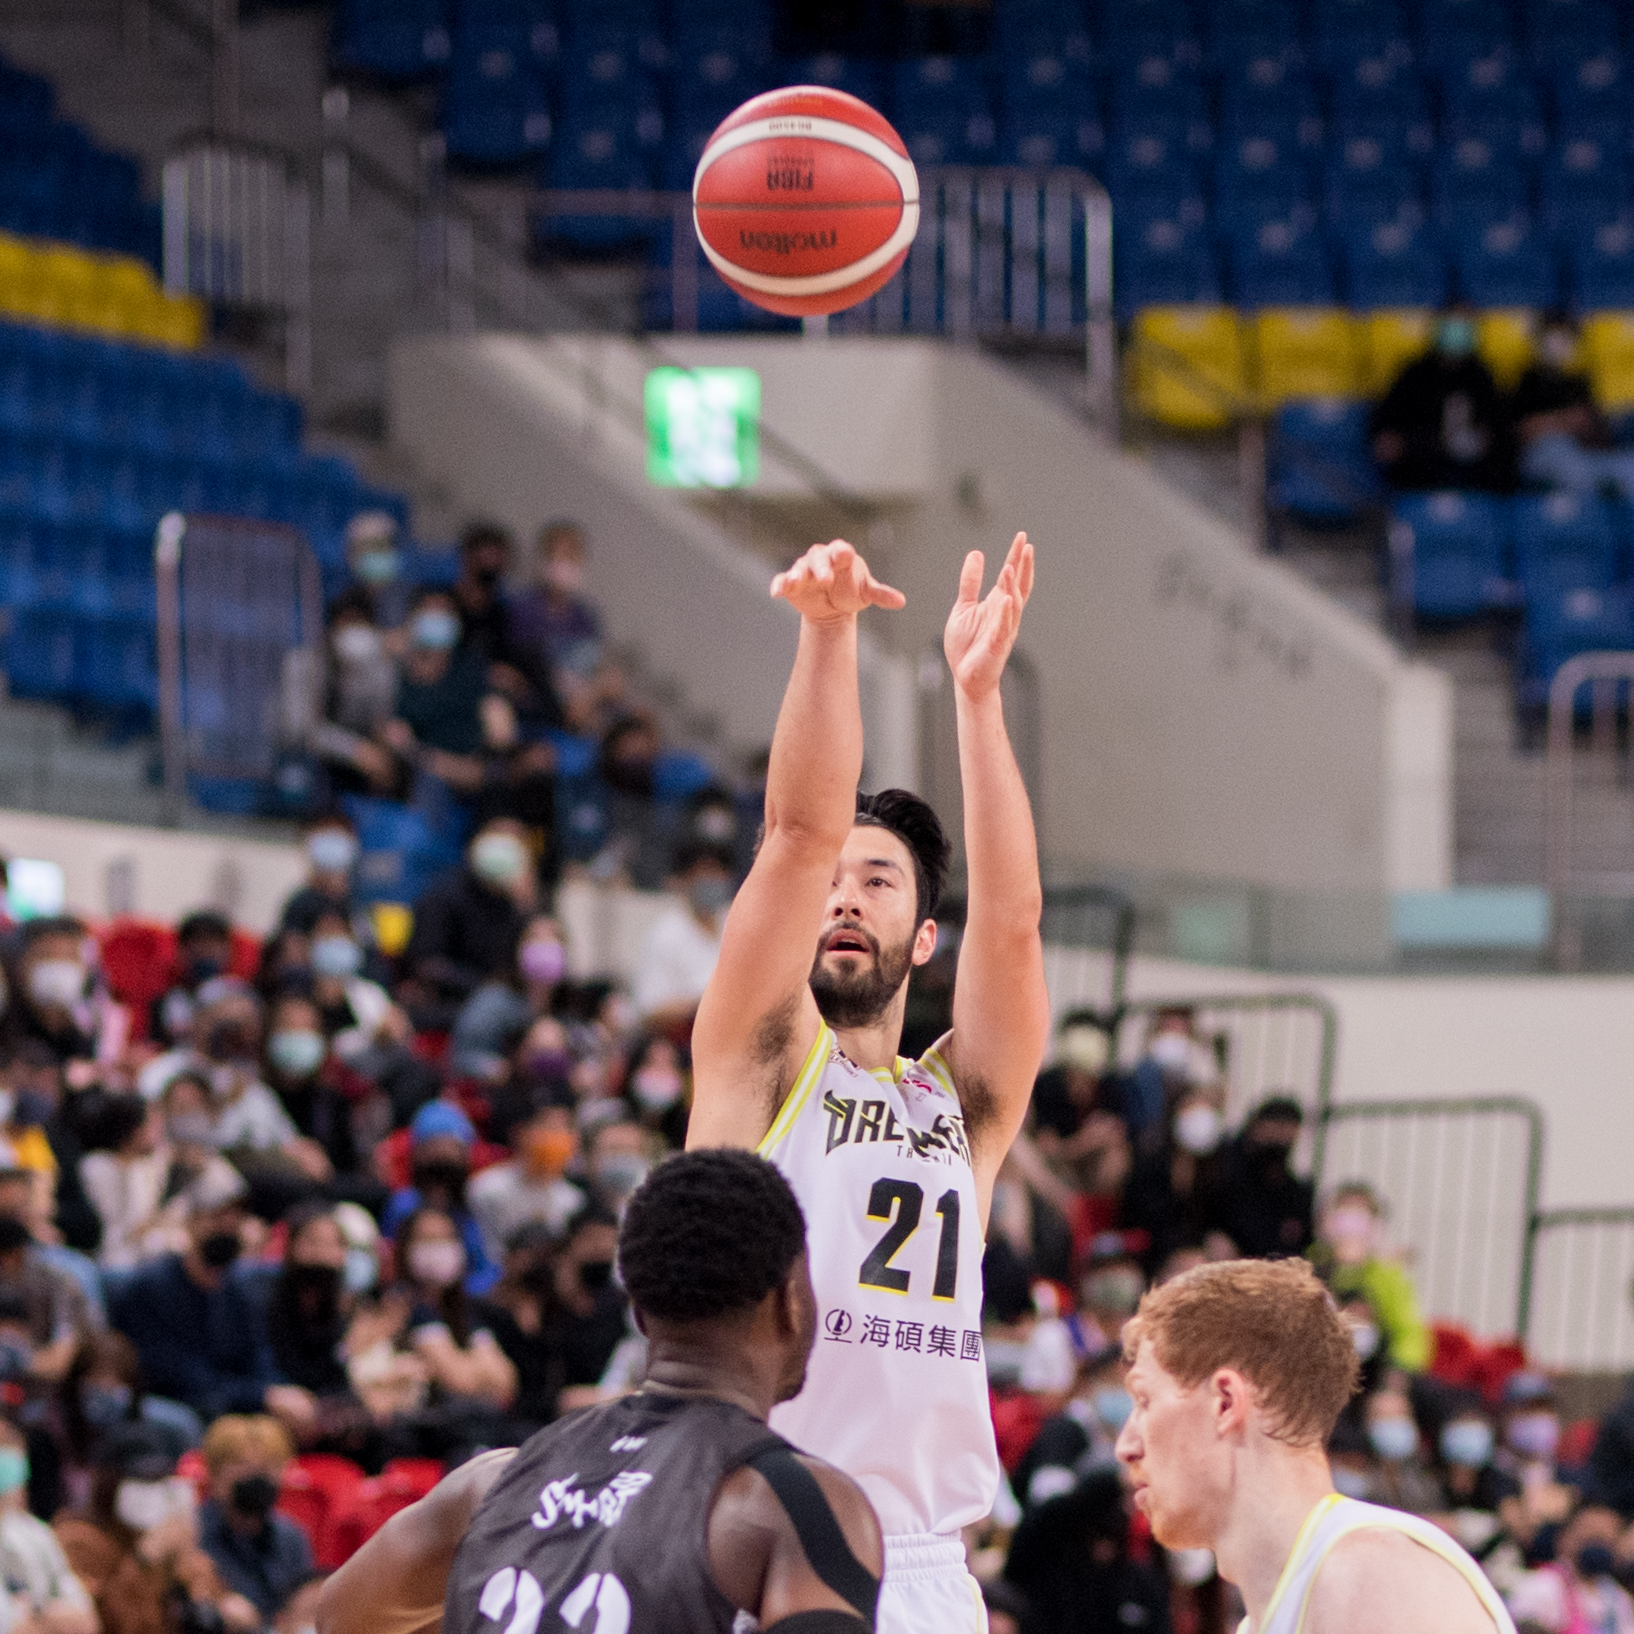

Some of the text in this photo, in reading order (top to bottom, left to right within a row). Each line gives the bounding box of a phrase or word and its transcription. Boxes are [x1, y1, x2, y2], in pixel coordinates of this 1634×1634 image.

[858, 1176, 961, 1304] 21
[860, 1313, 983, 1362] 海碩集團
